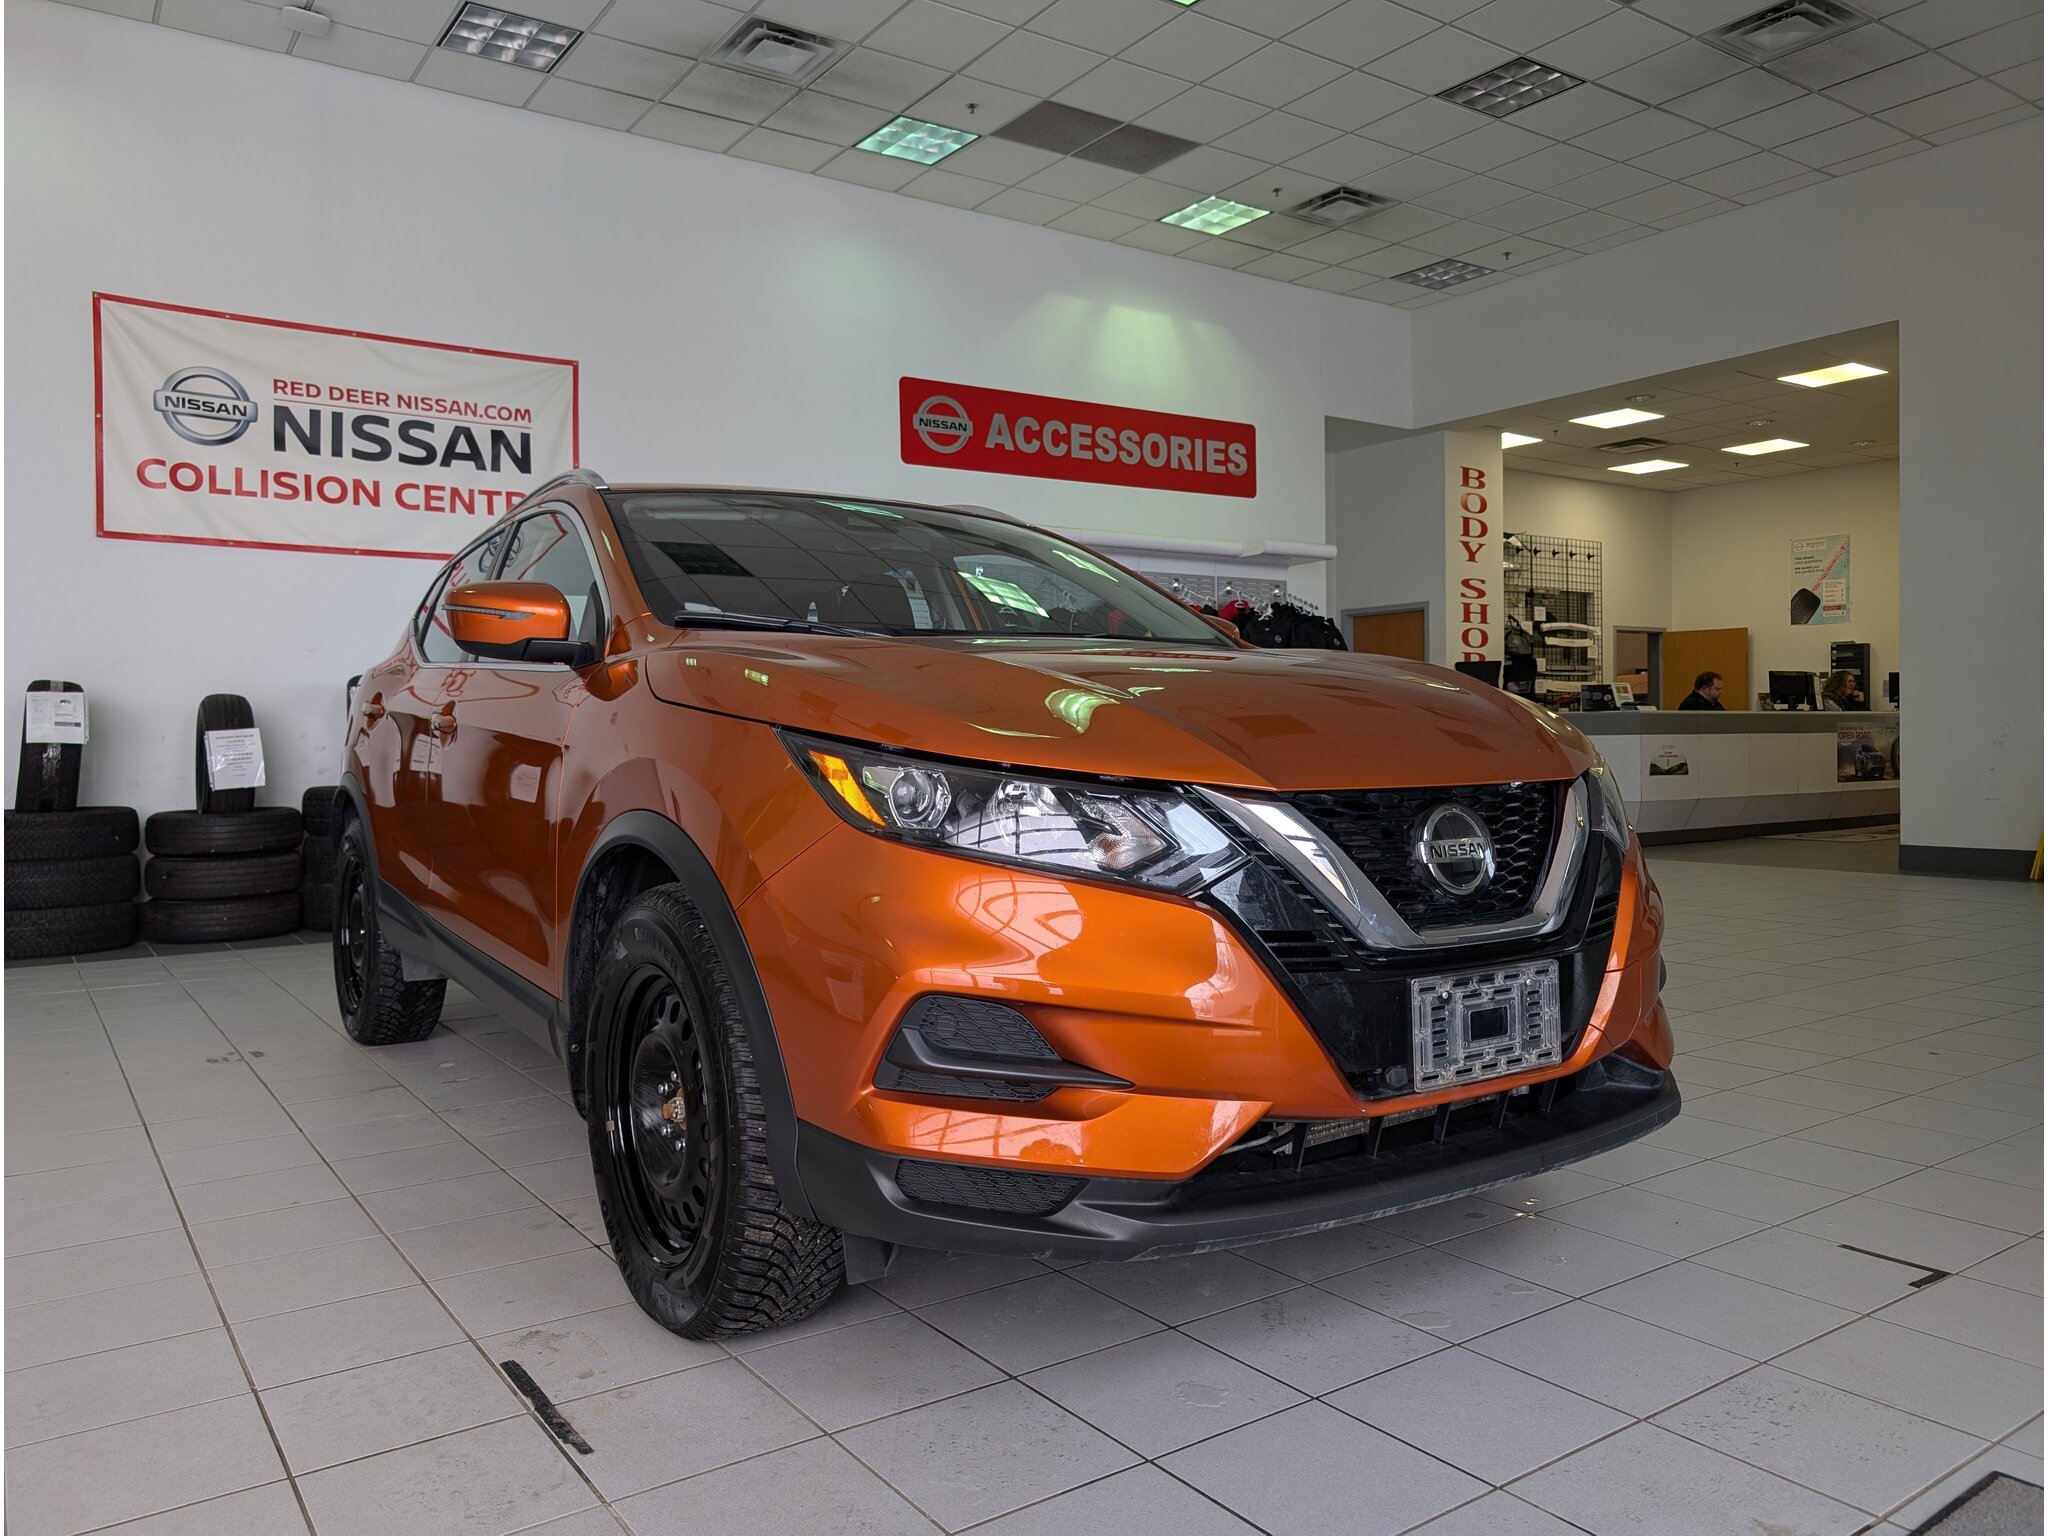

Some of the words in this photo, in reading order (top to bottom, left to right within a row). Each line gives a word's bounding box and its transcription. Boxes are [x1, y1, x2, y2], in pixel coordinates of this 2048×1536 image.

[164, 395, 247, 417] NISSAN
[273, 378, 322, 398] RED
[328, 386, 390, 407] DEER
[397, 394, 532, 423] NISSAN.COM
[273, 404, 532, 475] NISSAN
[918, 417, 968, 432] NISSAN
[985, 413, 1248, 476] ACCESSORIES
[136, 458, 381, 507] COLLISION
[1459, 466, 1488, 563] BODY
[1430, 842, 1485, 859] NISSAN
